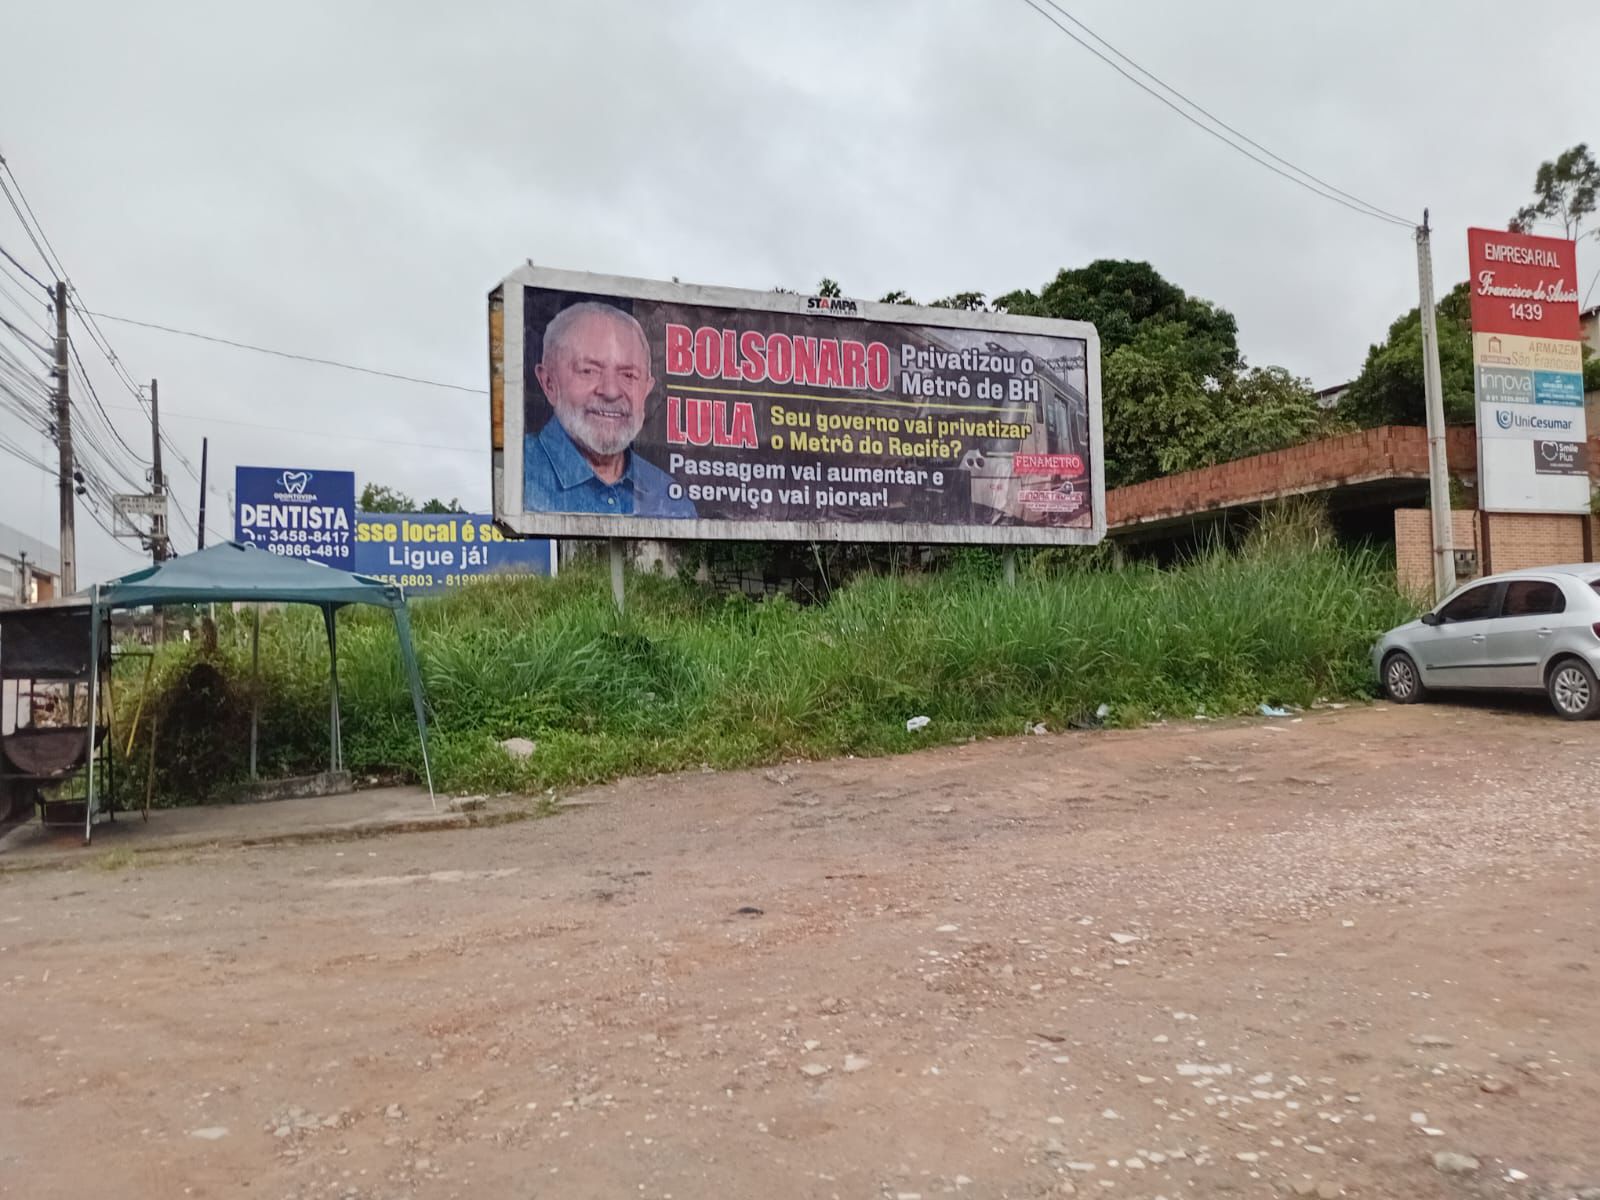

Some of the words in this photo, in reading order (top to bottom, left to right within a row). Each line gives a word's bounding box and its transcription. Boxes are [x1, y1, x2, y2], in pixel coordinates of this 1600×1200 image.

[1485, 243, 1560, 269] EMPRESARIAL
[1477, 270, 1533, 299] Francisco
[1533, 280, 1546, 300] de
[1546, 279, 1578, 303] Assis
[807, 297, 858, 312] STAMPA
[1509, 303, 1543, 321] 1439
[666, 324, 890, 392] BOLSONARO
[901, 344, 1015, 374] Privatizou
[1021, 358, 1034, 375] o
[901, 372, 971, 399] Metrô
[976, 378, 1003, 400] de
[1008, 380, 1039, 401] BH
[667, 396, 758, 449] LULA
[770, 405, 811, 427] Seu
[816, 411, 899, 431] governo
[904, 417, 933, 435] vai
[938, 419, 1032, 440] privatizar
[1514, 415, 1572, 430] UniCesumar
[770, 435, 784, 450] o
[789, 431, 853, 454] Metrô
[858, 438, 884, 455] do
[888, 438, 962, 459] Recife?
[1559, 443, 1578, 453] Smile
[1559, 453, 1574, 462] Plus
[669, 453, 785, 481] Passagem
[790, 461, 822, 481] vai
[827, 464, 928, 486] aumentar
[932, 471, 944, 486] e
[1016, 456, 1080, 468] FENAMETRO
[669, 484, 682, 499] o
[688, 484, 773, 509] serviço
[778, 486, 810, 505] vai
[816, 488, 889, 509] piorar!
[240, 503, 349, 530] DENTISTA
[269, 529, 349, 543] 3458-8417
[354, 520, 398, 543] sse
[401, 520, 457, 543] local
[461, 520, 475, 543] é
[268, 543, 349, 557] 99866-4819
[388, 547, 454, 569] Ligue
[459, 546, 488, 570] já!
